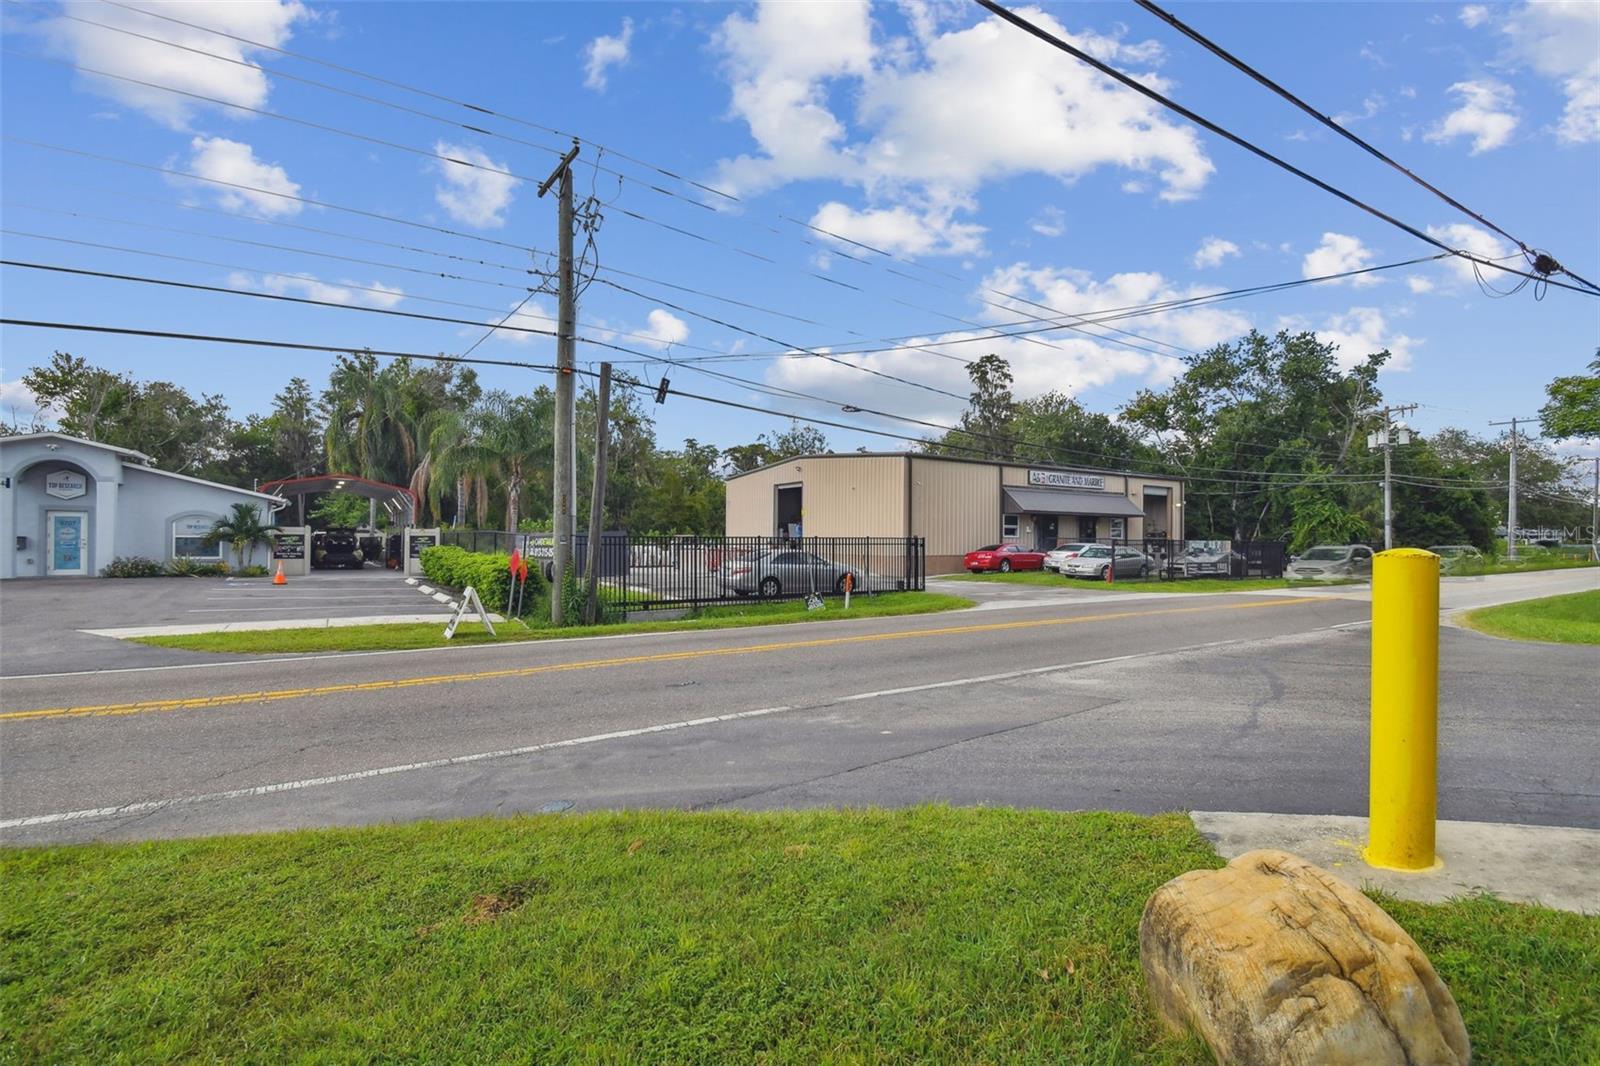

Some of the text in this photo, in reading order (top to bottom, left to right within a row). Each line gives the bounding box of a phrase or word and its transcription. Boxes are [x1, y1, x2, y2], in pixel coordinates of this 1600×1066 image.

[58, 482, 82, 490] RESEARCH
[1048, 473, 1070, 485] GRANITE
[1071, 475, 1083, 486] AND
[1084, 476, 1104, 488] MARBLE
